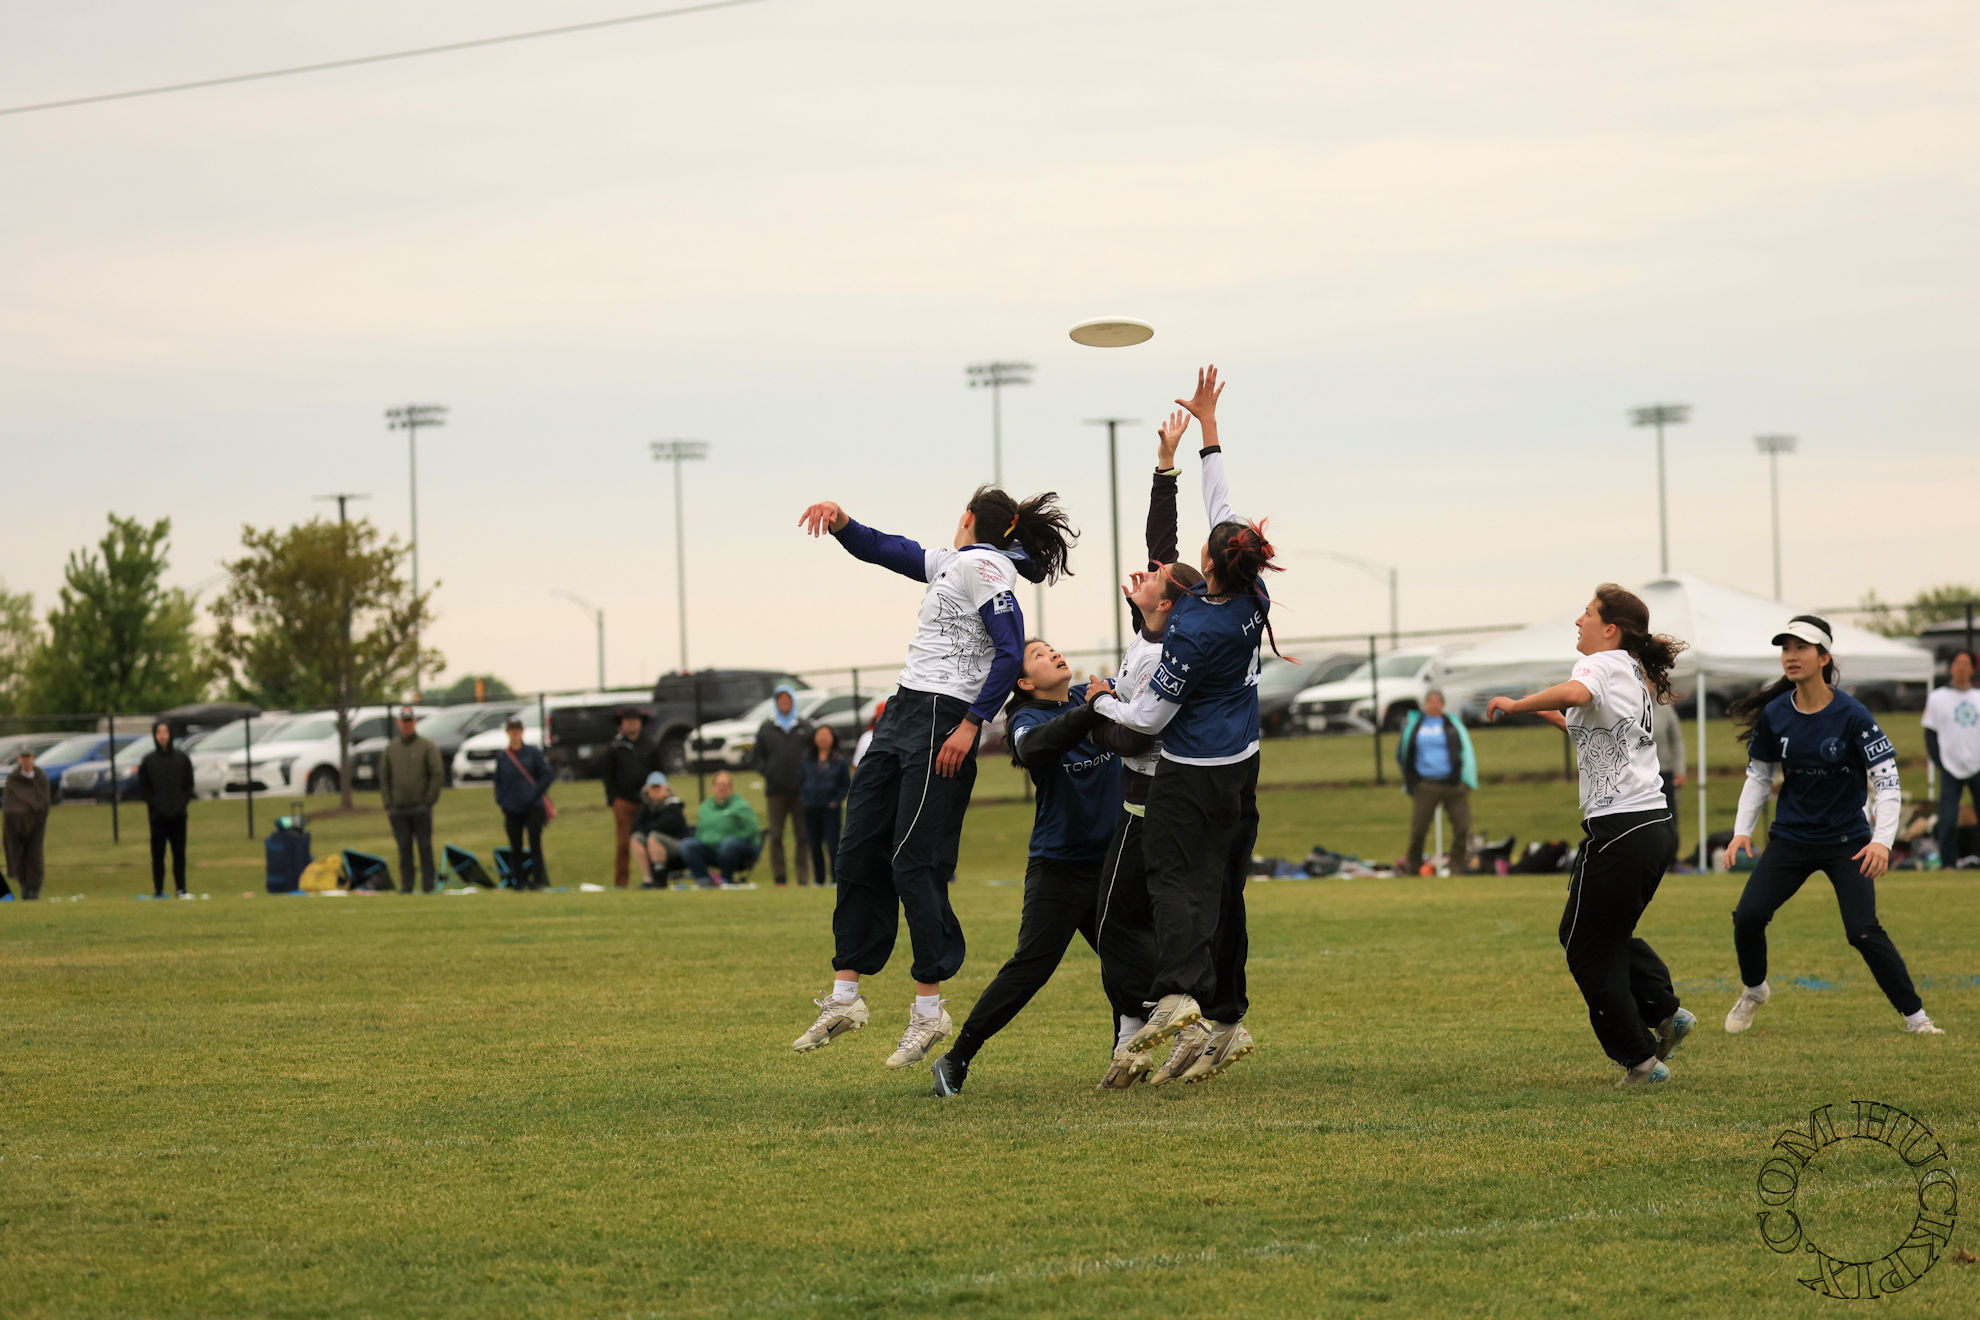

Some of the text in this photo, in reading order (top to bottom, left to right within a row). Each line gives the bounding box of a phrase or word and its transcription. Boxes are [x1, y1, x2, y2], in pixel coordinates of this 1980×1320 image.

[1157, 666, 1178, 692] TULA
[1780, 737, 1789, 758] 7
[1868, 740, 1894, 756] TUL
